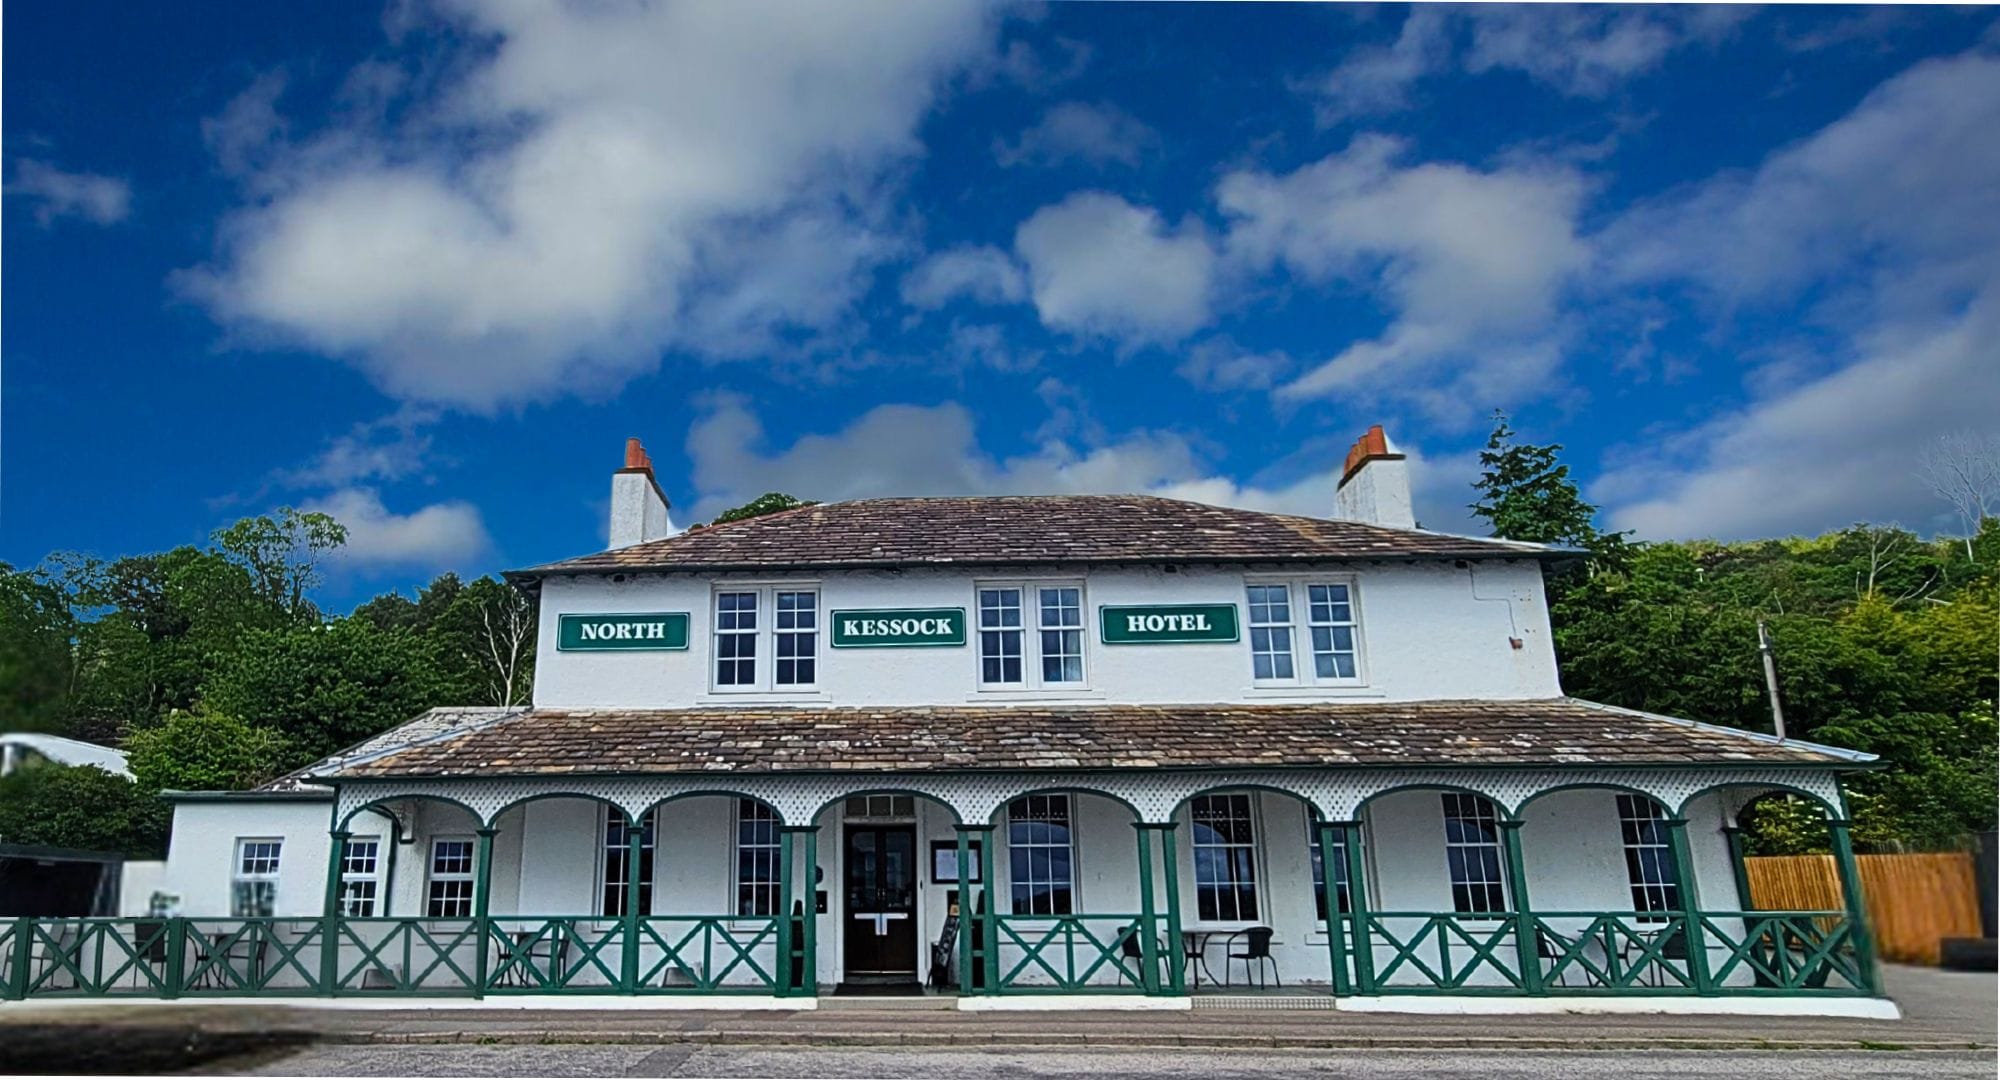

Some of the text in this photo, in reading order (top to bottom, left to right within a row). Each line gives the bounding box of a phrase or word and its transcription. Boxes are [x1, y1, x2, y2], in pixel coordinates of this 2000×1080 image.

[580, 622, 665, 640] NORTH
[843, 618, 953, 636] KESSOCK
[1127, 614, 1212, 632] HOTEL
